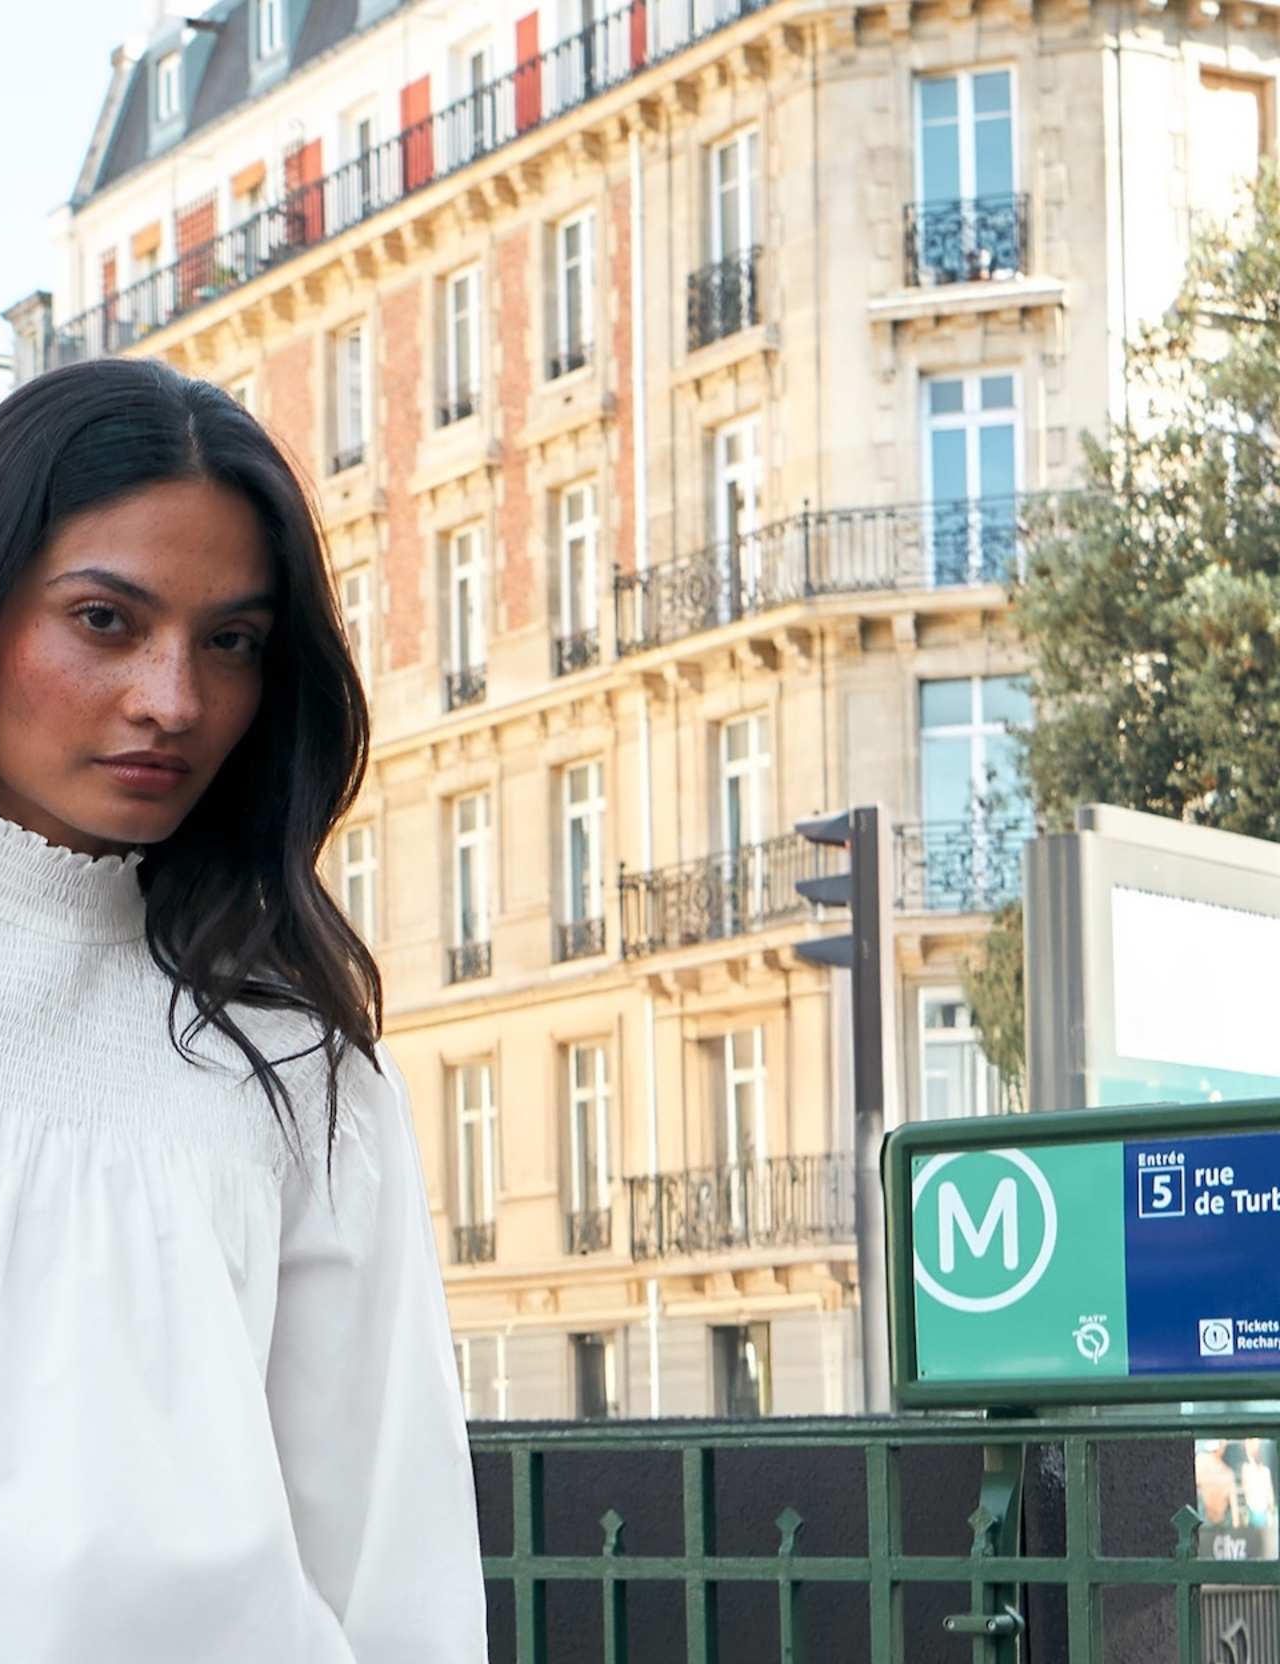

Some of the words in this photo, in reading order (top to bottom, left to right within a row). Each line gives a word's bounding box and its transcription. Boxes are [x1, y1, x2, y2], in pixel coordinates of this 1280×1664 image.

[1138, 1150, 1185, 1166] Entrée
[1195, 1166, 1234, 1187] rue
[1152, 1174, 1173, 1209] 5
[1194, 1191, 1225, 1215] de
[938, 1178, 1019, 1273] M
[1236, 1319, 1279, 1333] Tickets
[1237, 1335, 1280, 1350] Rechar
